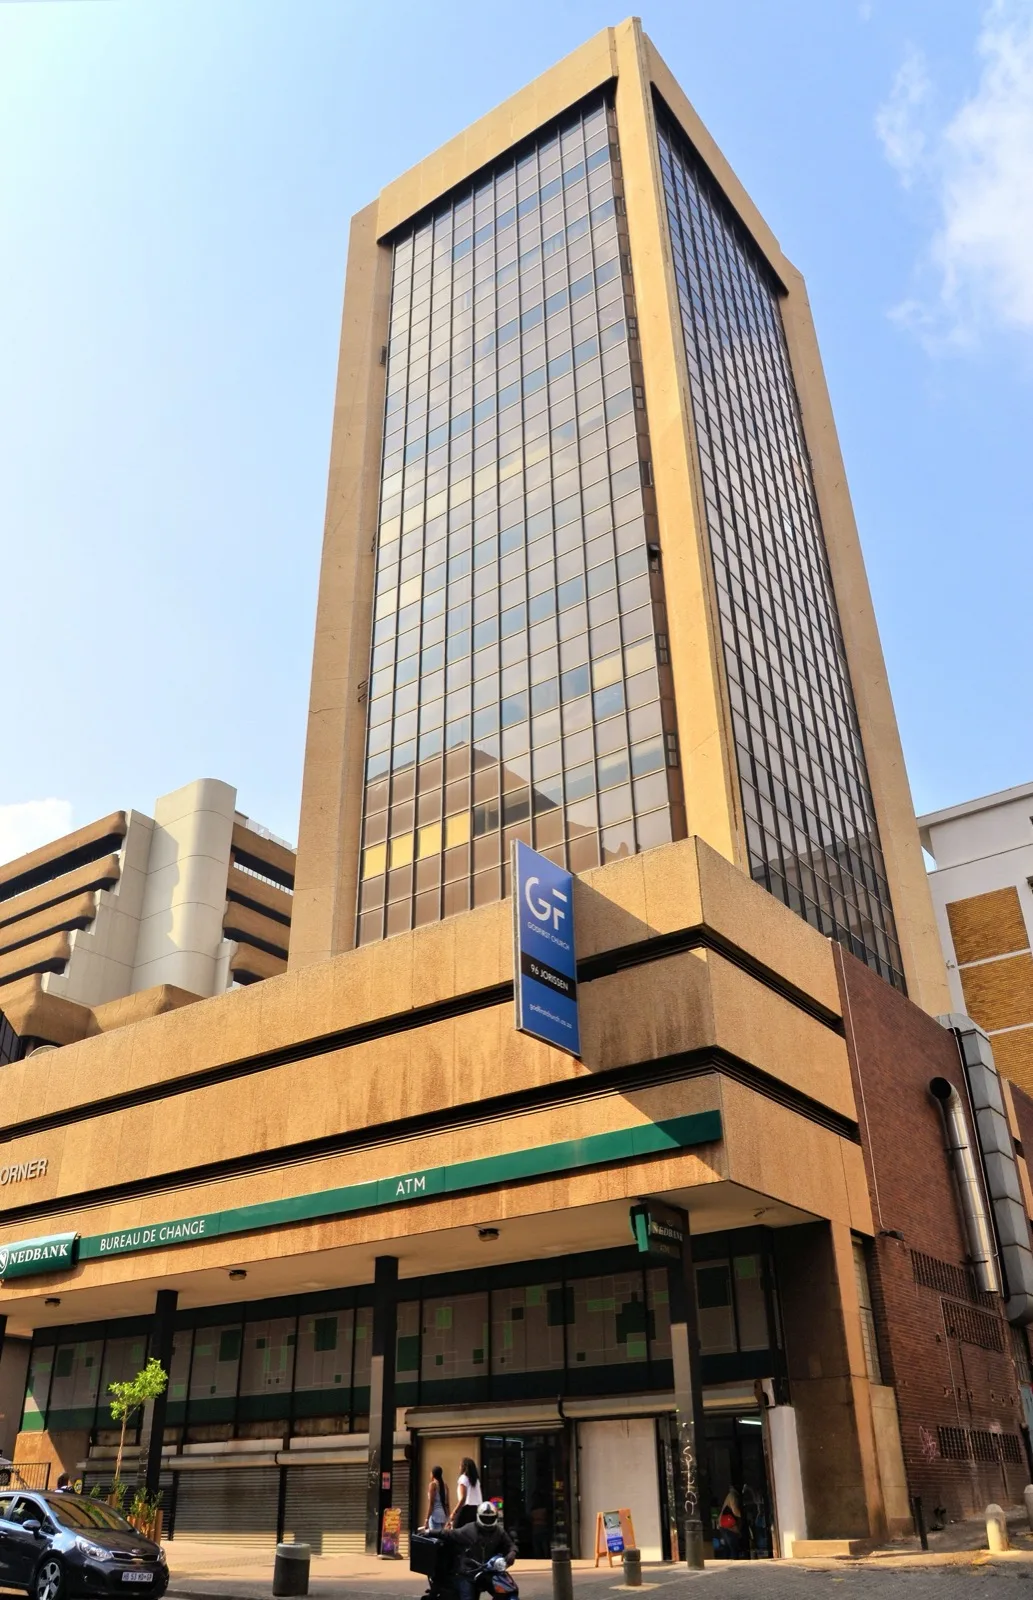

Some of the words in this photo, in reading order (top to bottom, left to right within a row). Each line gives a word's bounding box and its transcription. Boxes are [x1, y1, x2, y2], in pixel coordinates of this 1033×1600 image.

[550, 935, 570, 950] CHURCH
[530, 963, 540, 975] 96
[540, 969, 569, 991] JORISSEN
[395, 1175, 426, 1196] ATM
[100, 1231, 141, 1251] BUREAU
[142, 1229, 157, 1244] DE
[159, 1219, 206, 1241] CHANGE
[9, 1243, 69, 1265] NEDBANK
